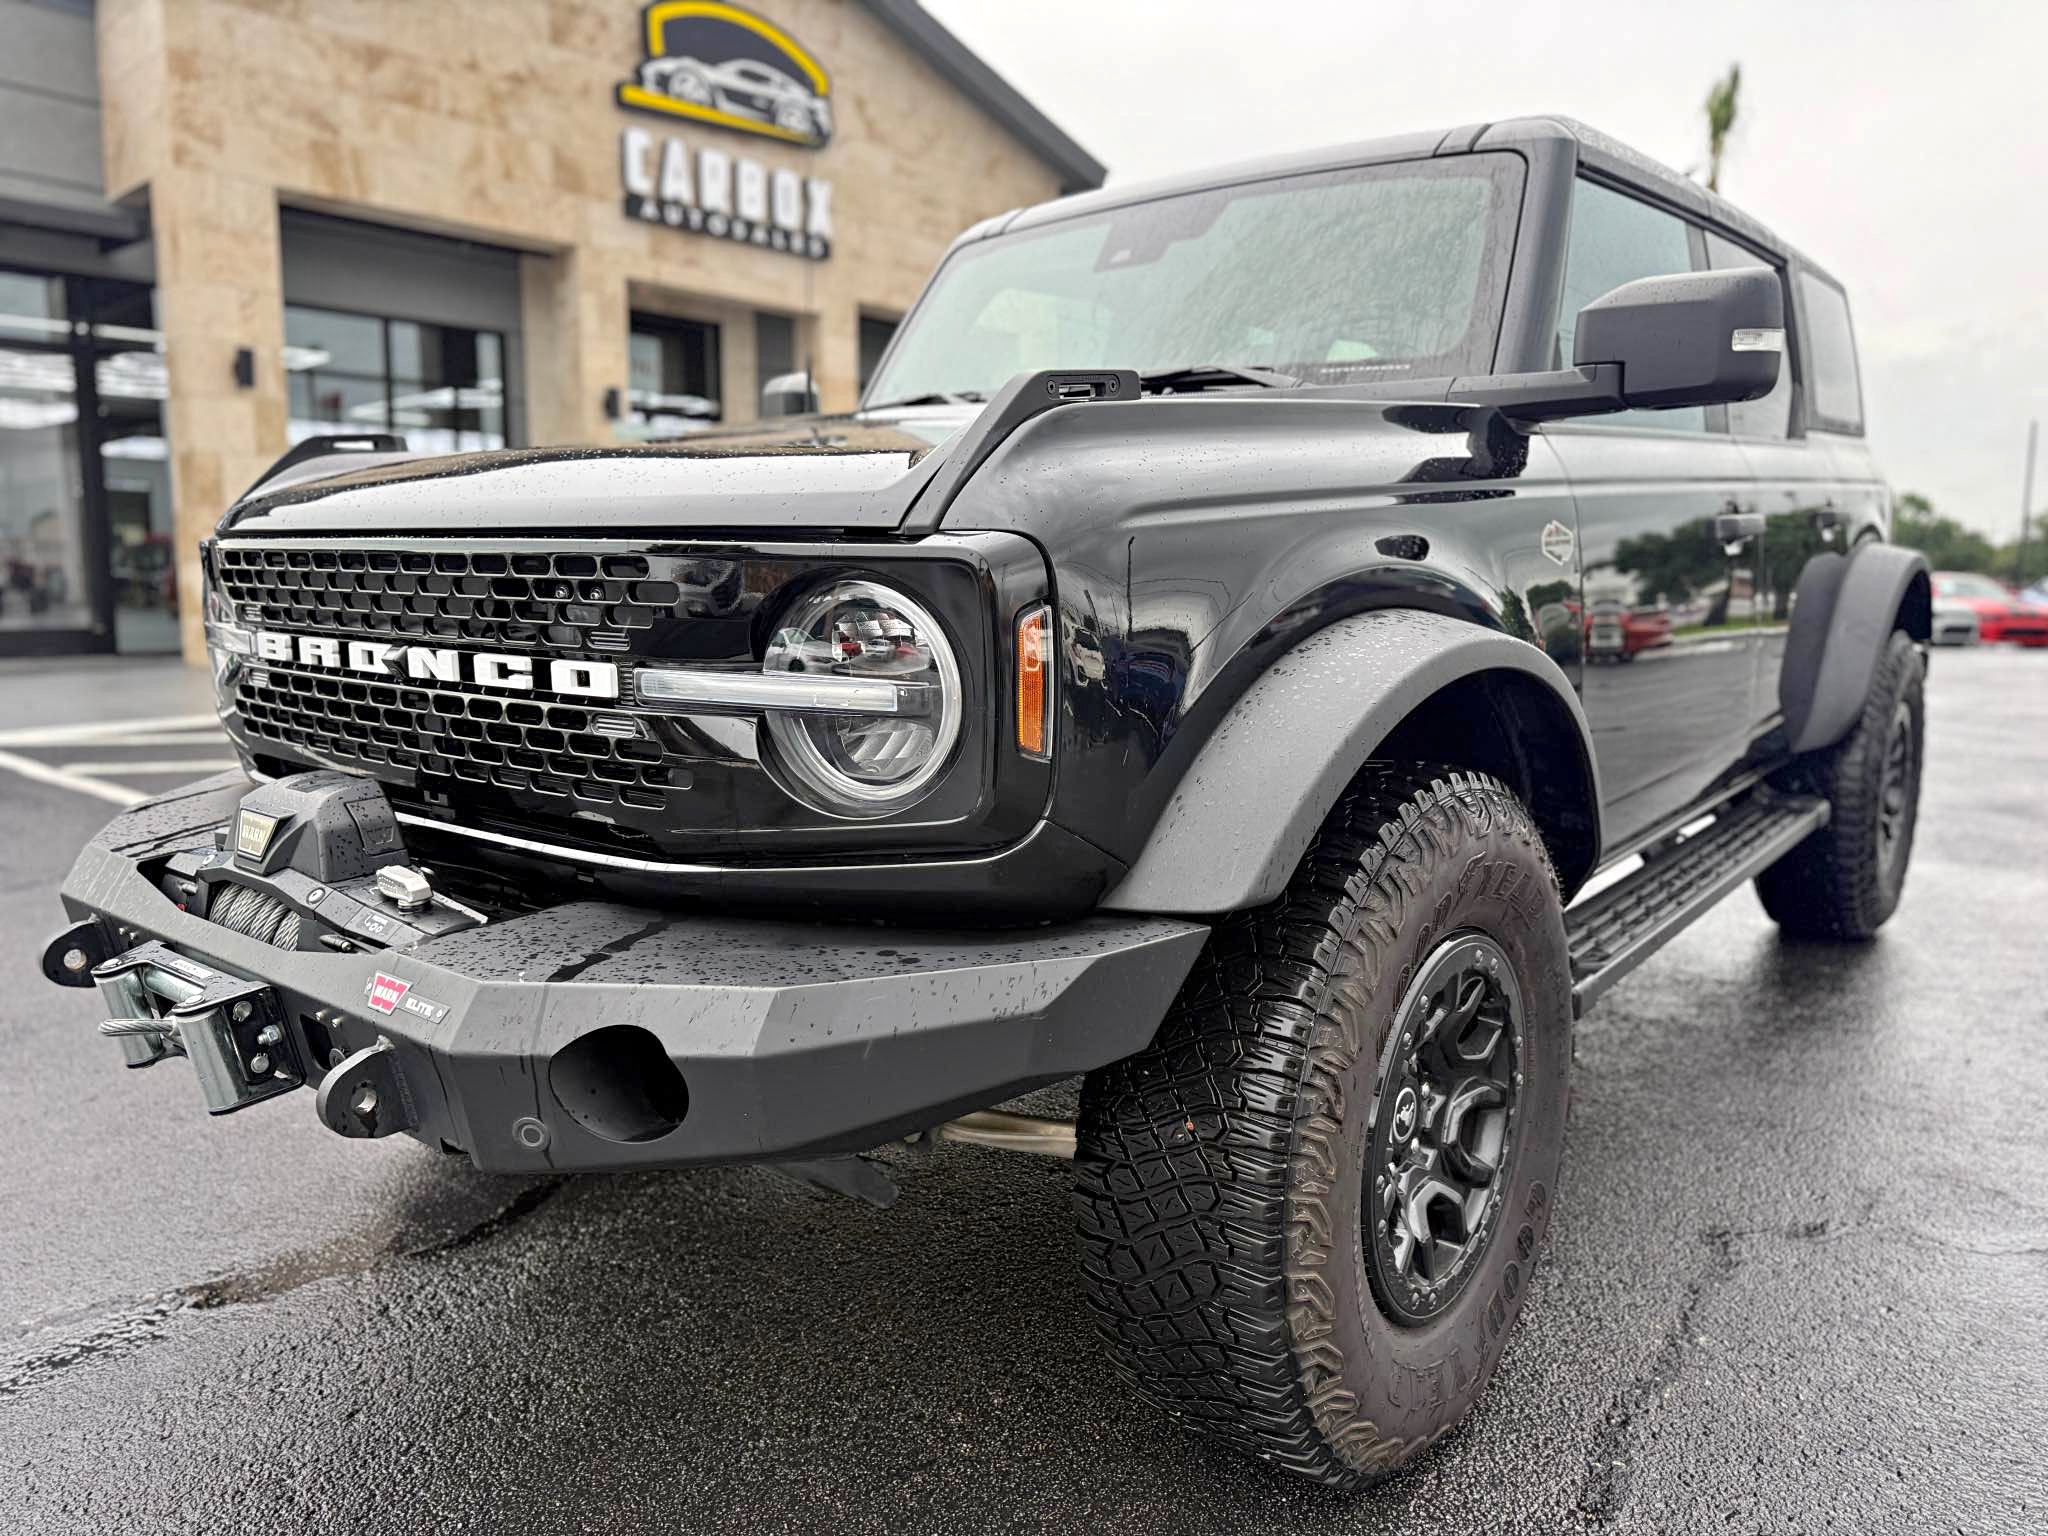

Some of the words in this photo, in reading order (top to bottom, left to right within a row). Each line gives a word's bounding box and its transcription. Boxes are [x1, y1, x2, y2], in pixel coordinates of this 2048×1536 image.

[622, 126, 832, 238] CARBOX
[639, 203, 825, 258] AUTOSALES
[257, 632, 617, 698] BRONCO
[373, 983, 400, 1004] WARN
[404, 996, 435, 1018] ELITE
